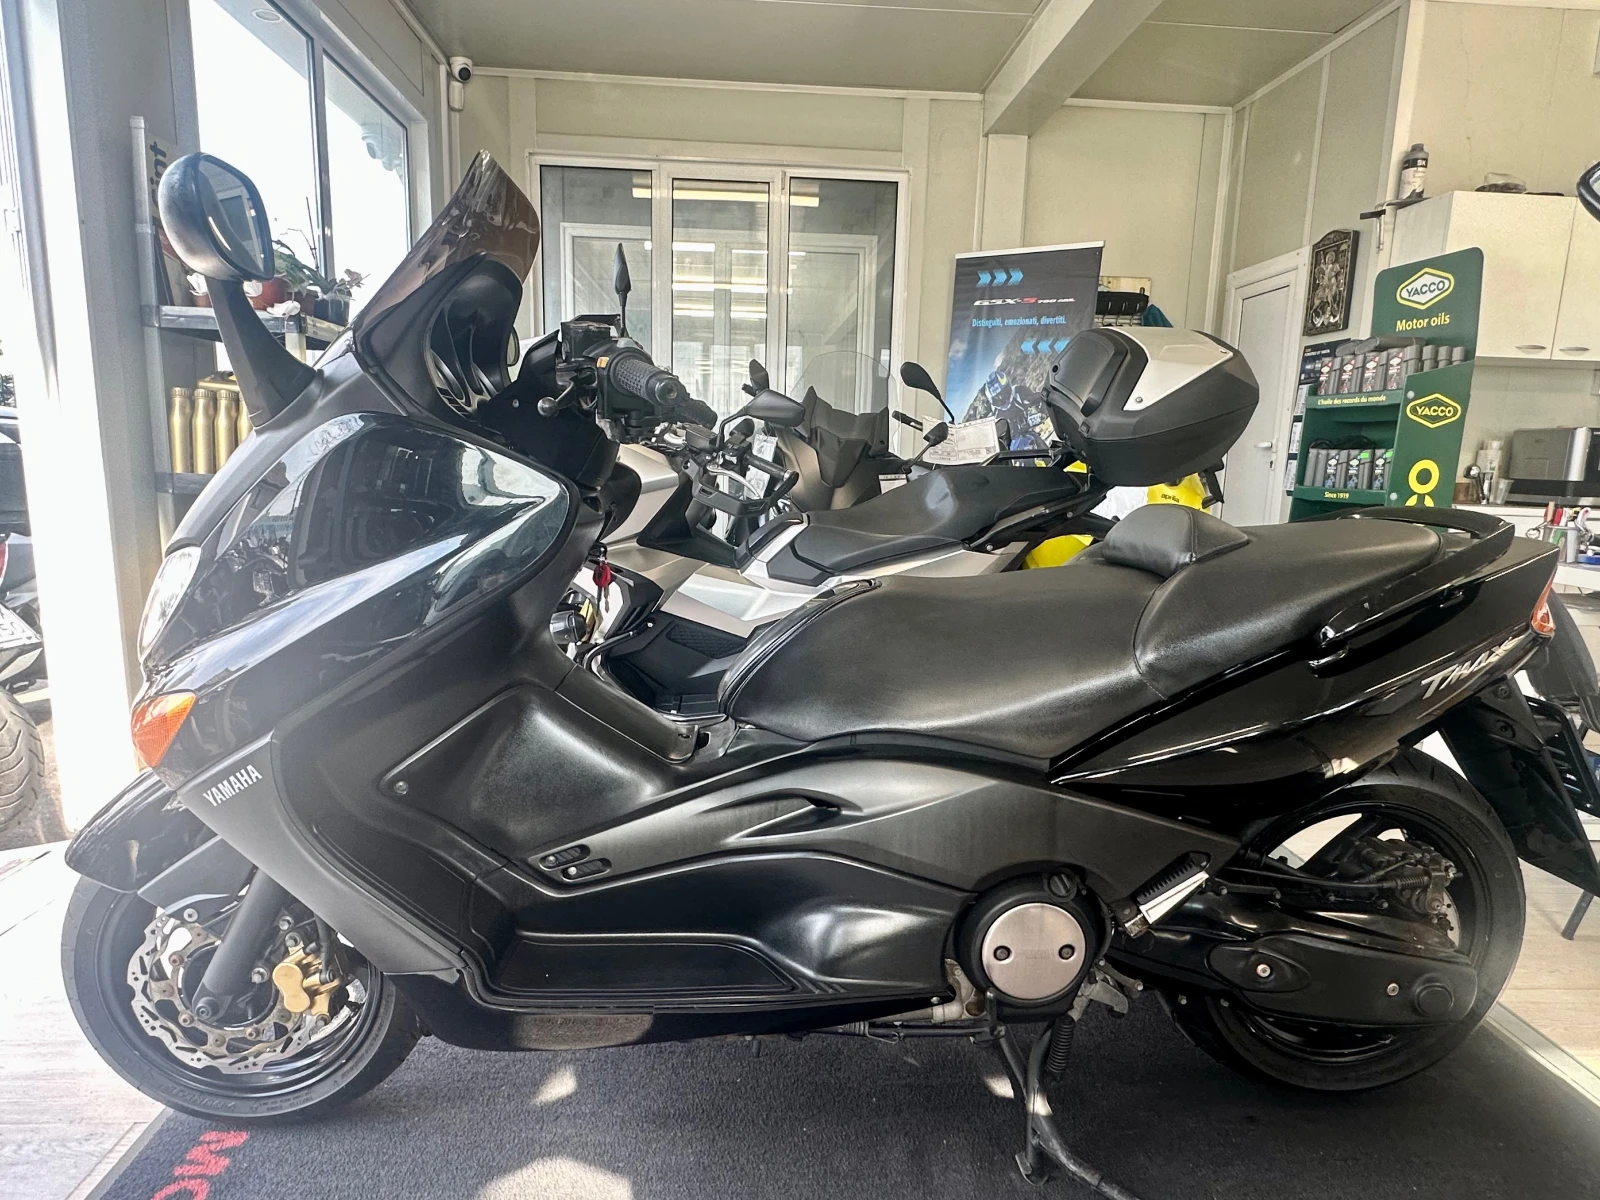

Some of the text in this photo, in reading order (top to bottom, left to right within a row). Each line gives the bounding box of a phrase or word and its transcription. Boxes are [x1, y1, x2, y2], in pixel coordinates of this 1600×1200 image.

[1406, 280, 1446, 298] YACCO
[972, 314, 1067, 328] Distinguiti, emozionati, divertiti.
[1396, 312, 1450, 332] Motor oils
[1360, 395, 1367, 403] du
[1368, 394, 1386, 402] monde
[1415, 405, 1454, 417] YACCO
[1324, 491, 1349, 500] Since 1919
[202, 764, 263, 807] YAMAHA
